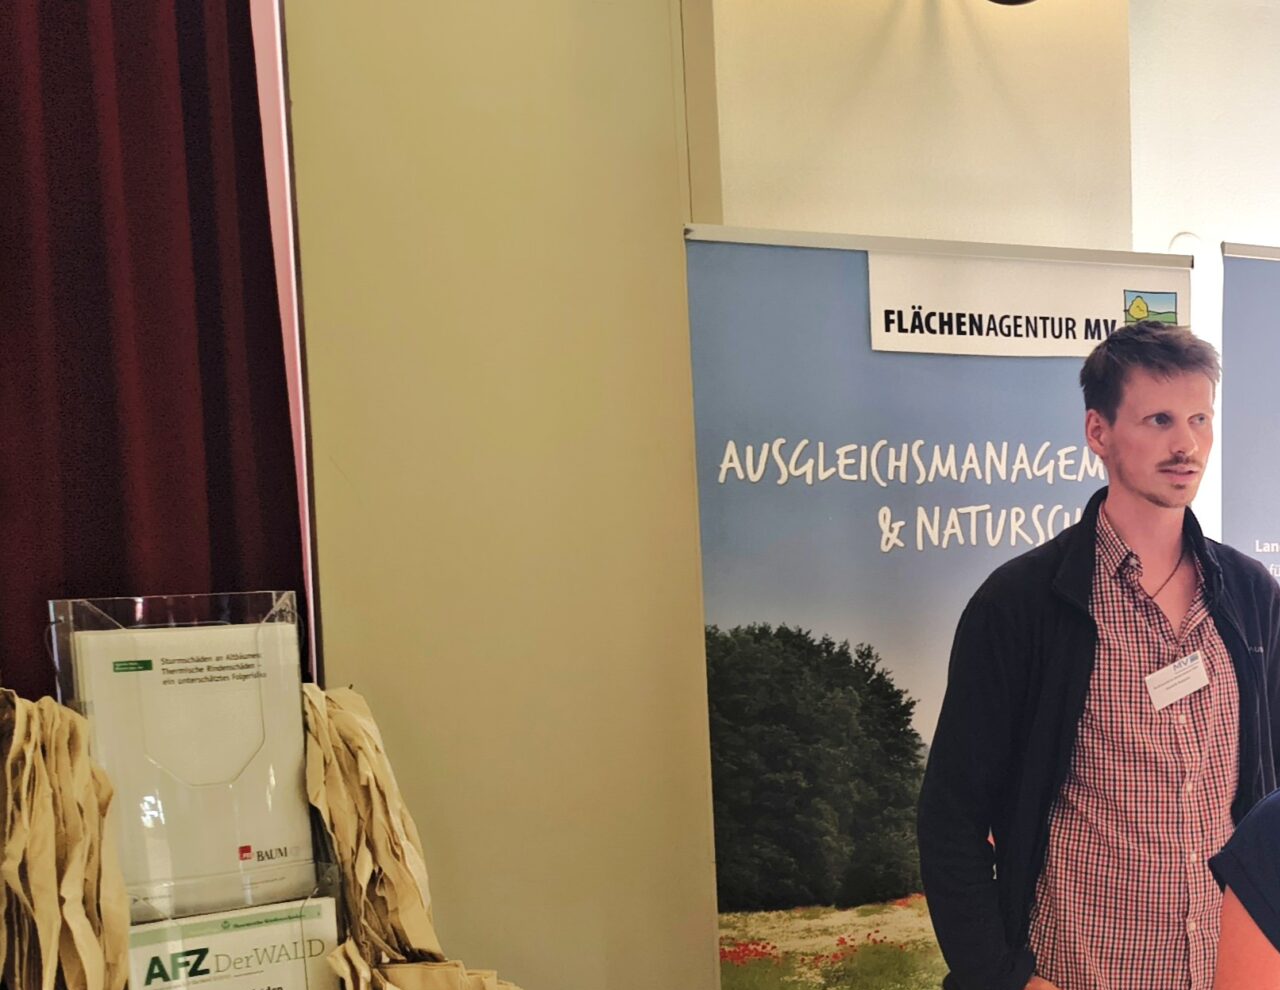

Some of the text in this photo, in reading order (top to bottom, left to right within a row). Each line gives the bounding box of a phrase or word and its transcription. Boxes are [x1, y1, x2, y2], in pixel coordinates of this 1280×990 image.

[884, 305, 1117, 340] FLÄCHENAGENTUR MV
[878, 506, 905, 553] &
[256, 847, 288, 862] BAUM
[144, 947, 210, 987] AFZ
[214, 938, 325, 974] DerWALD
